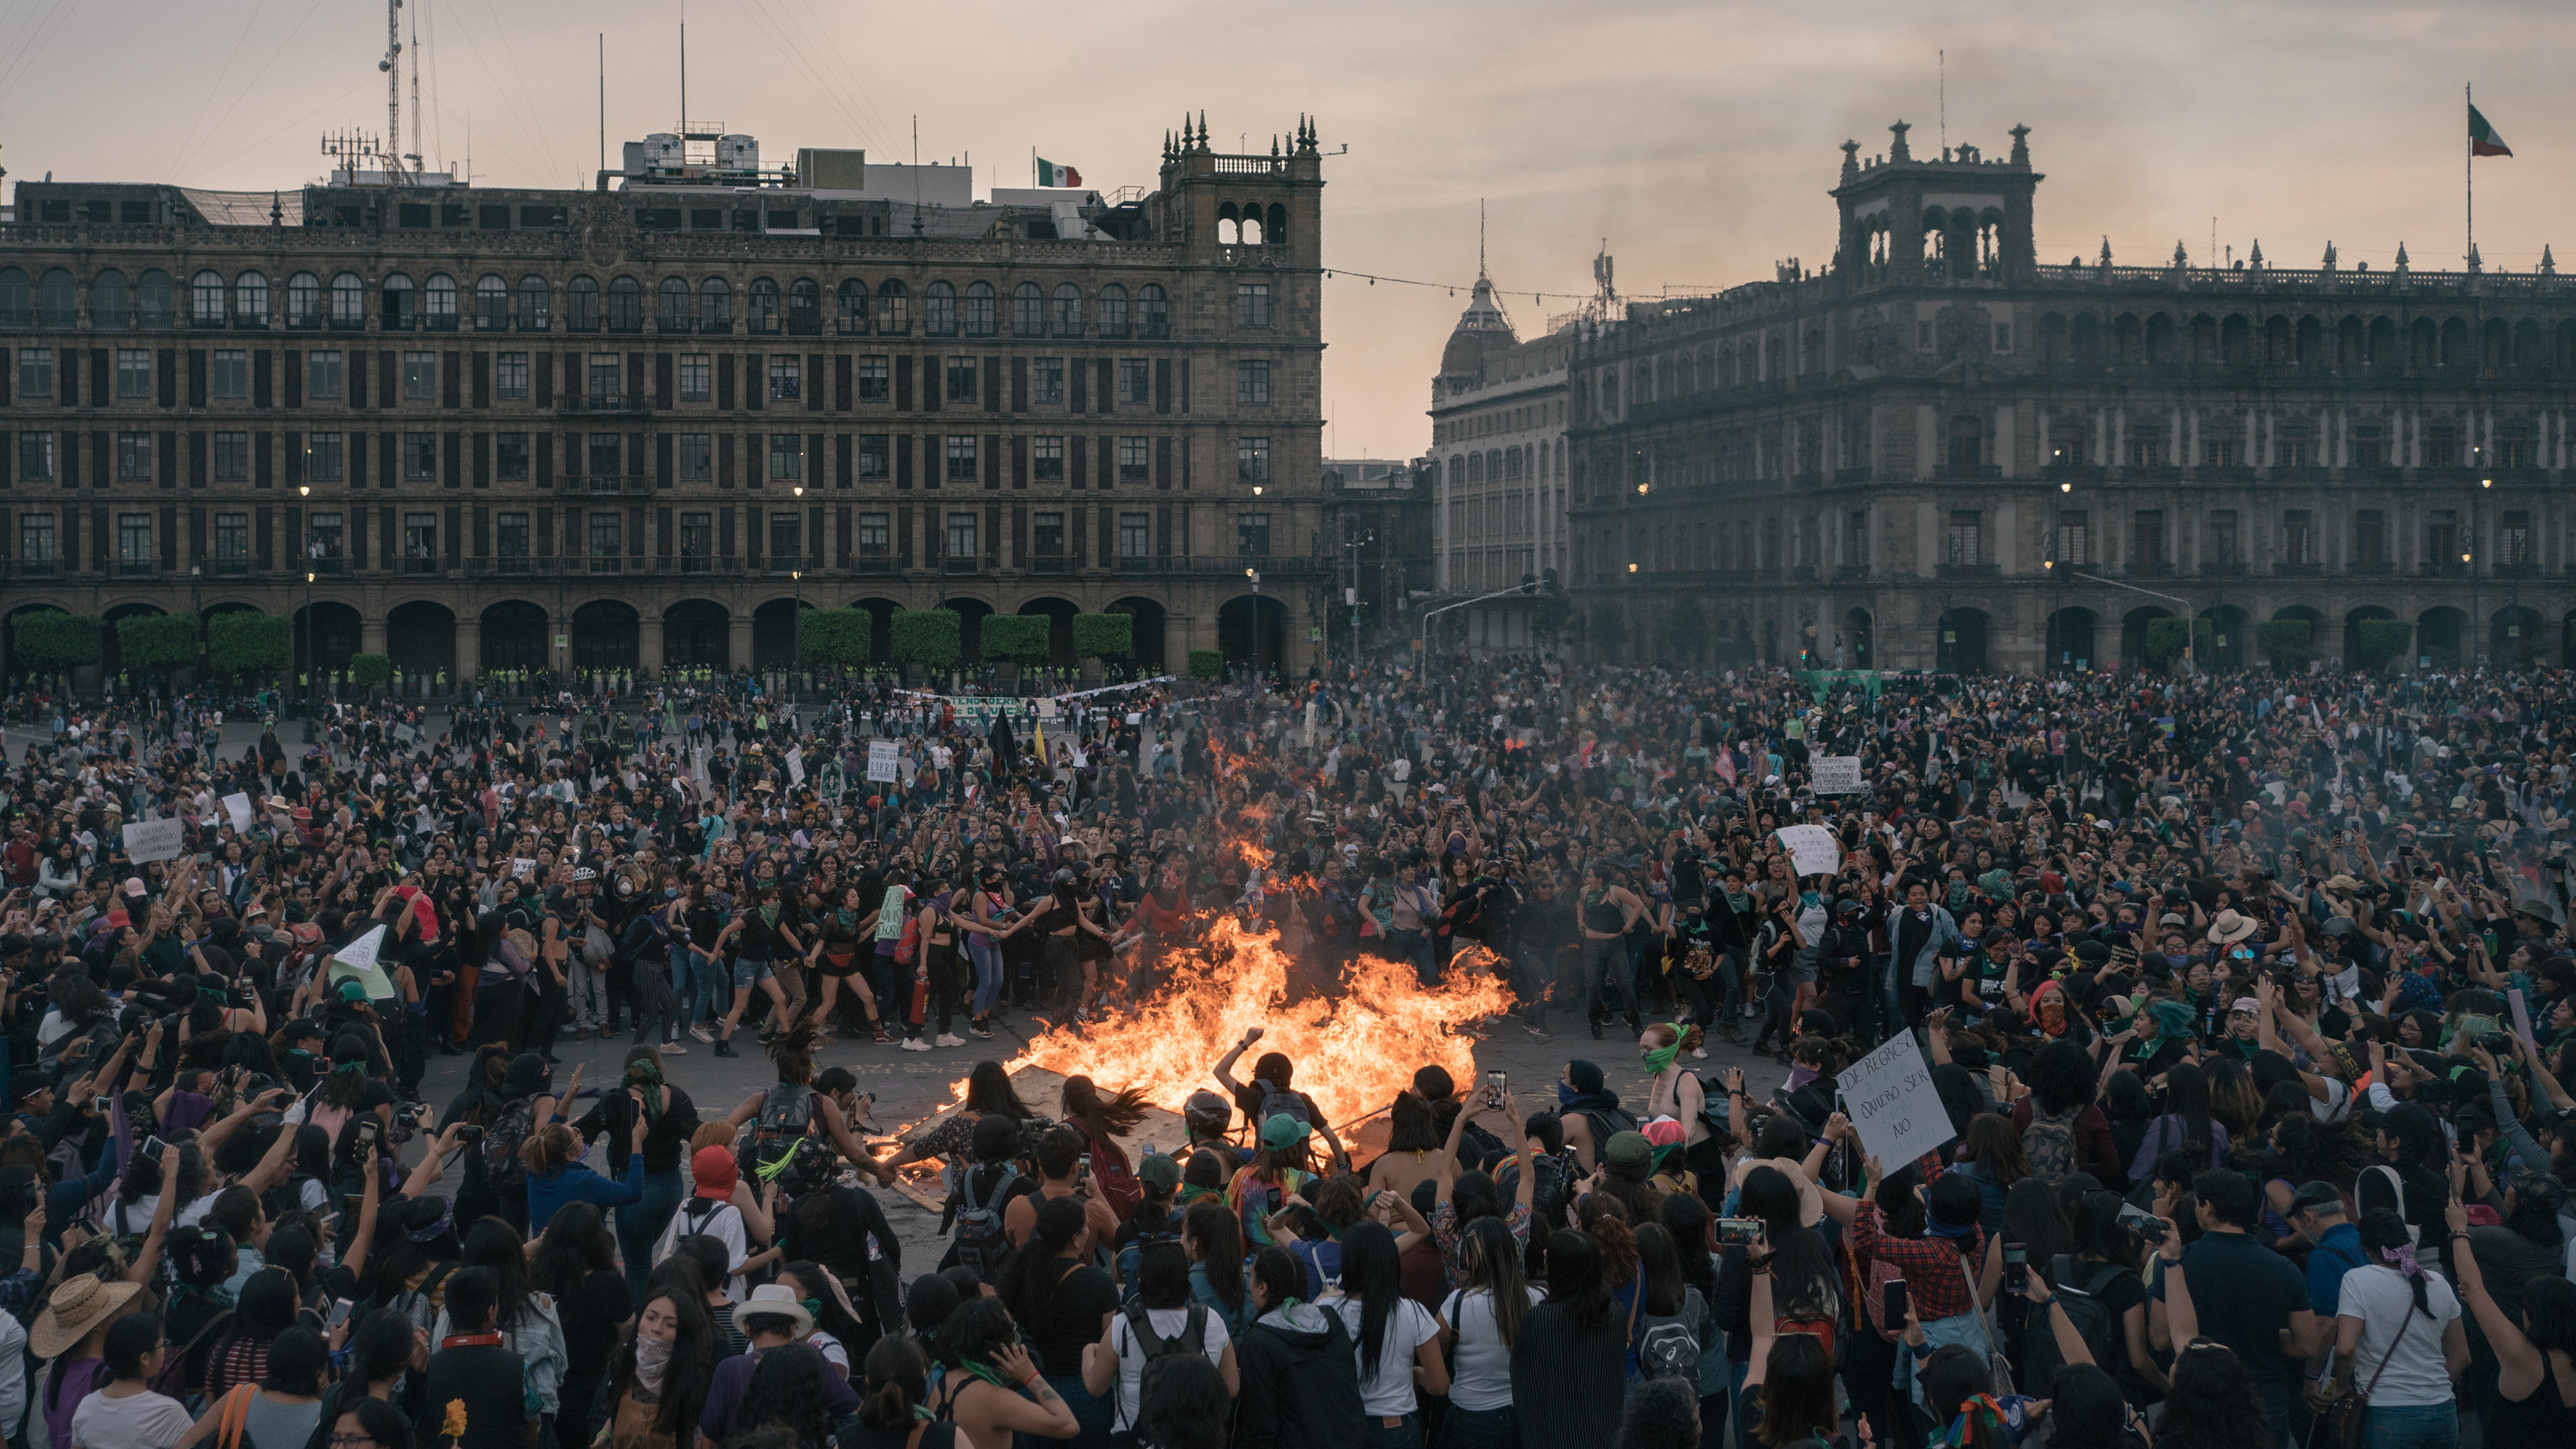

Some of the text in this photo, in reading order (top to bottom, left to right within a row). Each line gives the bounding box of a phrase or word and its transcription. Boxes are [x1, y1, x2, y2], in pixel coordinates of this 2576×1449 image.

[871, 761, 895, 772] LIBRE
[1841, 1034, 1915, 1091] DE REGRESO
[1874, 1062, 1909, 1088] CASA
[1861, 1070, 1930, 1119] QUIERO SER
[1882, 1096, 1915, 1125] LIBRE
[1893, 1118, 1911, 1139] NO
